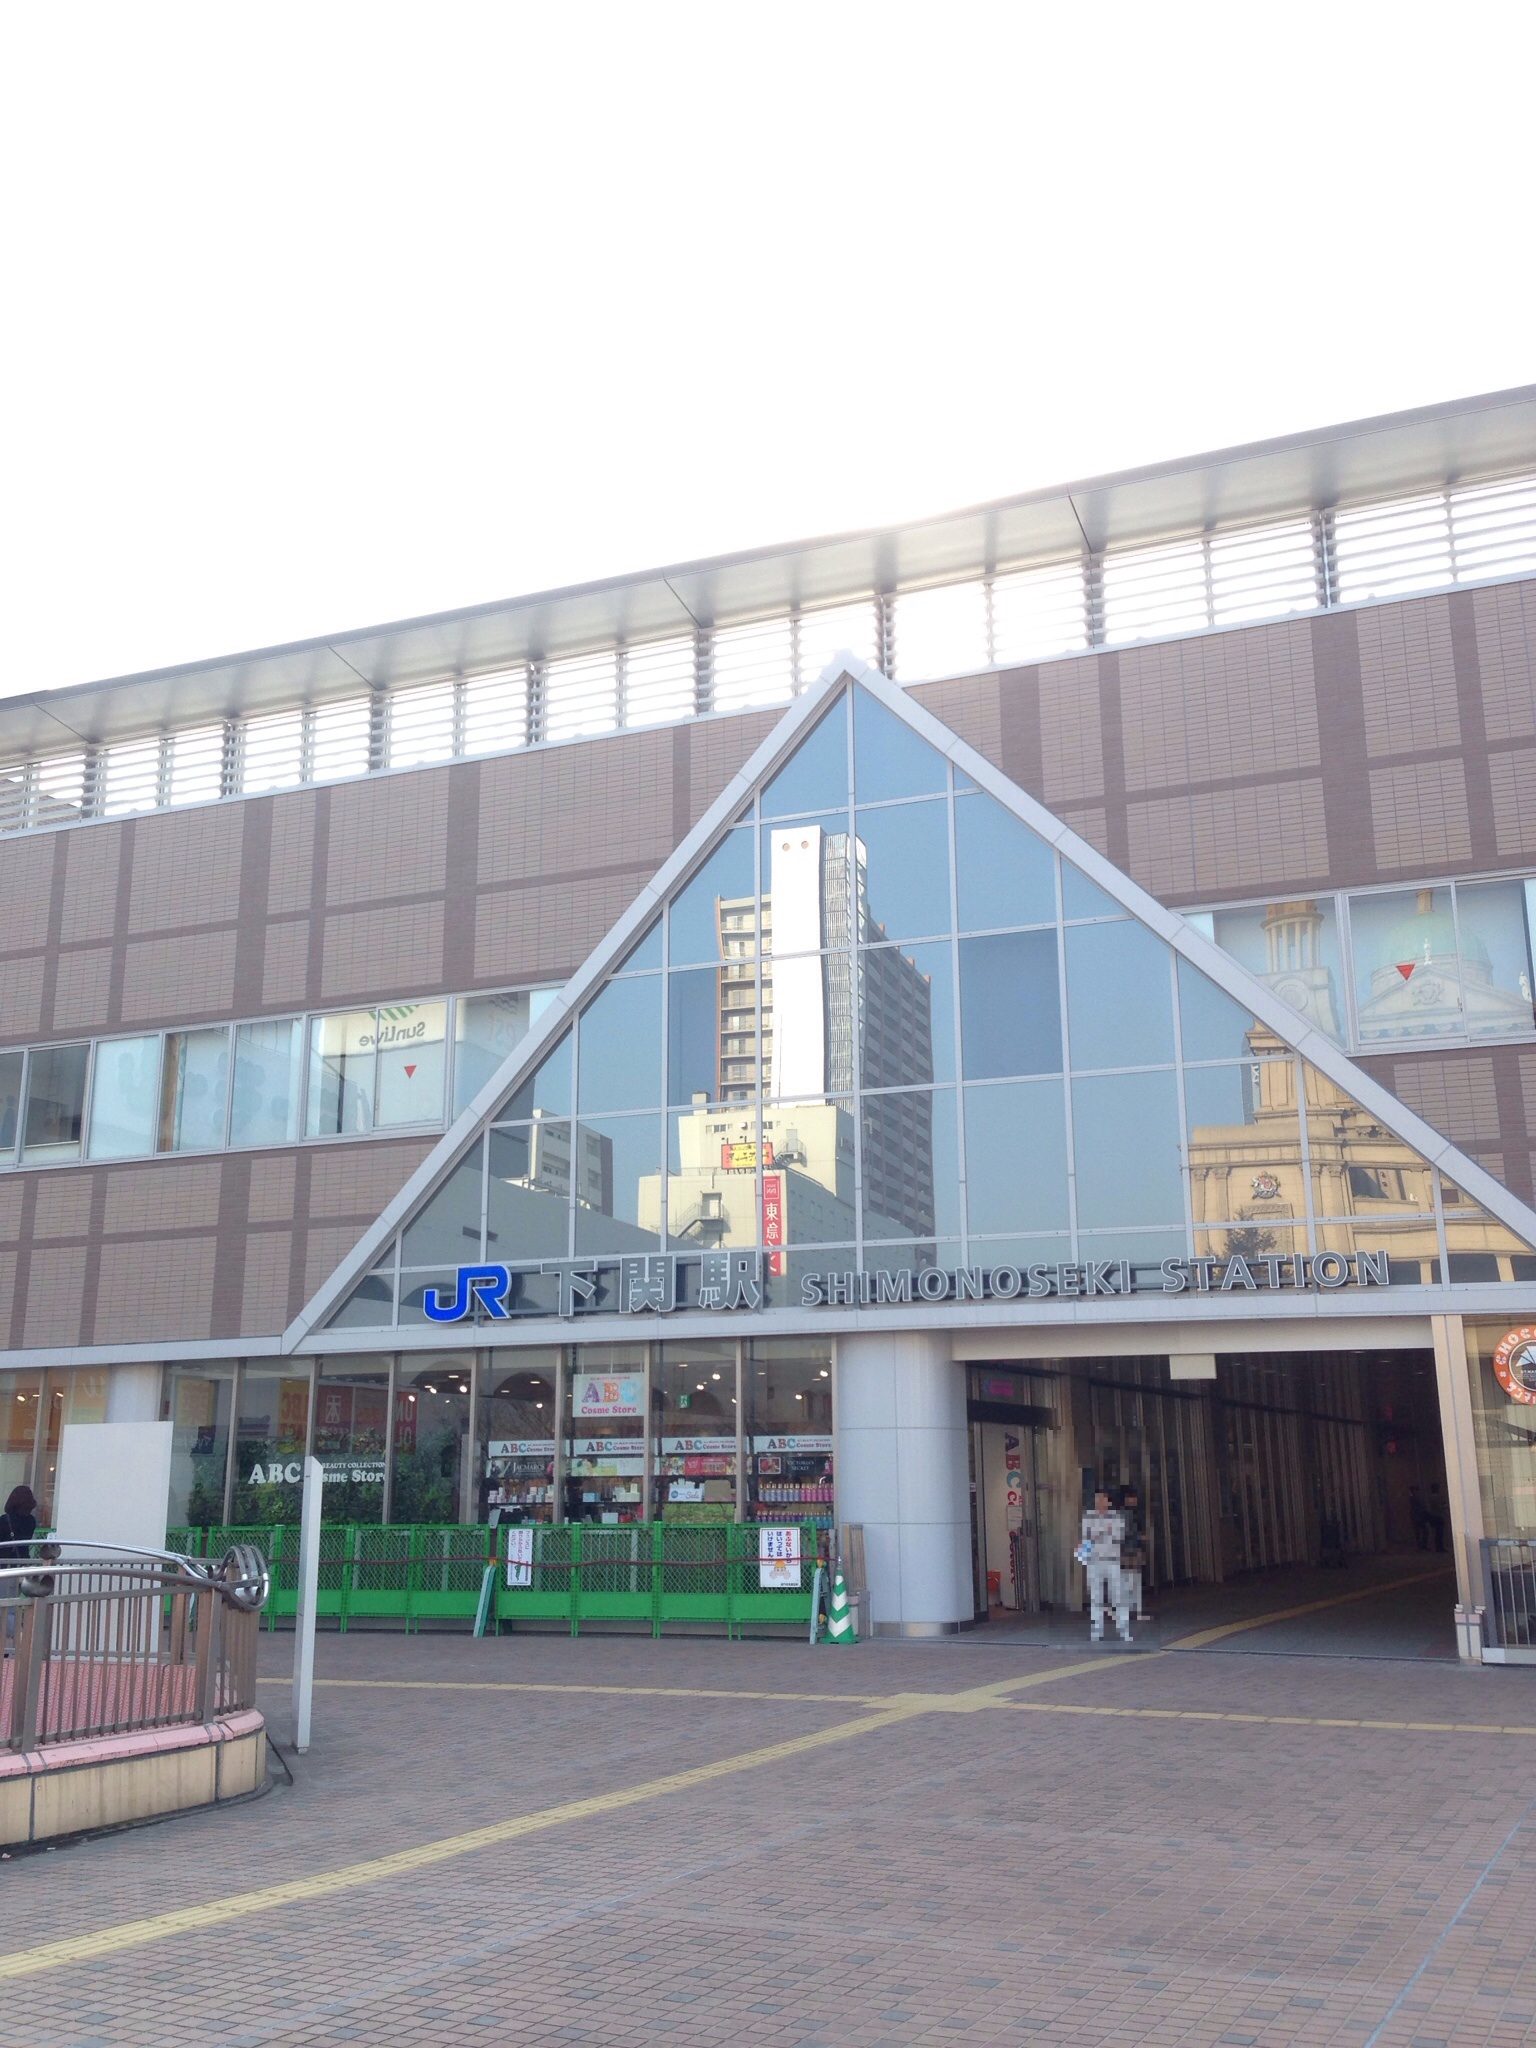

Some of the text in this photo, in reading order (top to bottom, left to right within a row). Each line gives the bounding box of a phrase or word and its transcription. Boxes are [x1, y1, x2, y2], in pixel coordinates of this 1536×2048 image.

[422, 1249, 762, 1324] JR 下関駅
[800, 1249, 1391, 1307] SHIMONOSEKI STATION
[1495, 1327, 1536, 1366] CHOC
[581, 1381, 642, 1404] ABC
[581, 1405, 637, 1415] Cosme Store
[501, 1442, 527, 1454] ABC
[586, 1441, 613, 1452] ABC
[675, 1439, 702, 1451] ABC
[767, 1438, 796, 1449] ABC
[1005, 1431, 1024, 1489] ABC
[248, 1462, 302, 1485] ABC
[322, 1472, 349, 1483] sme
